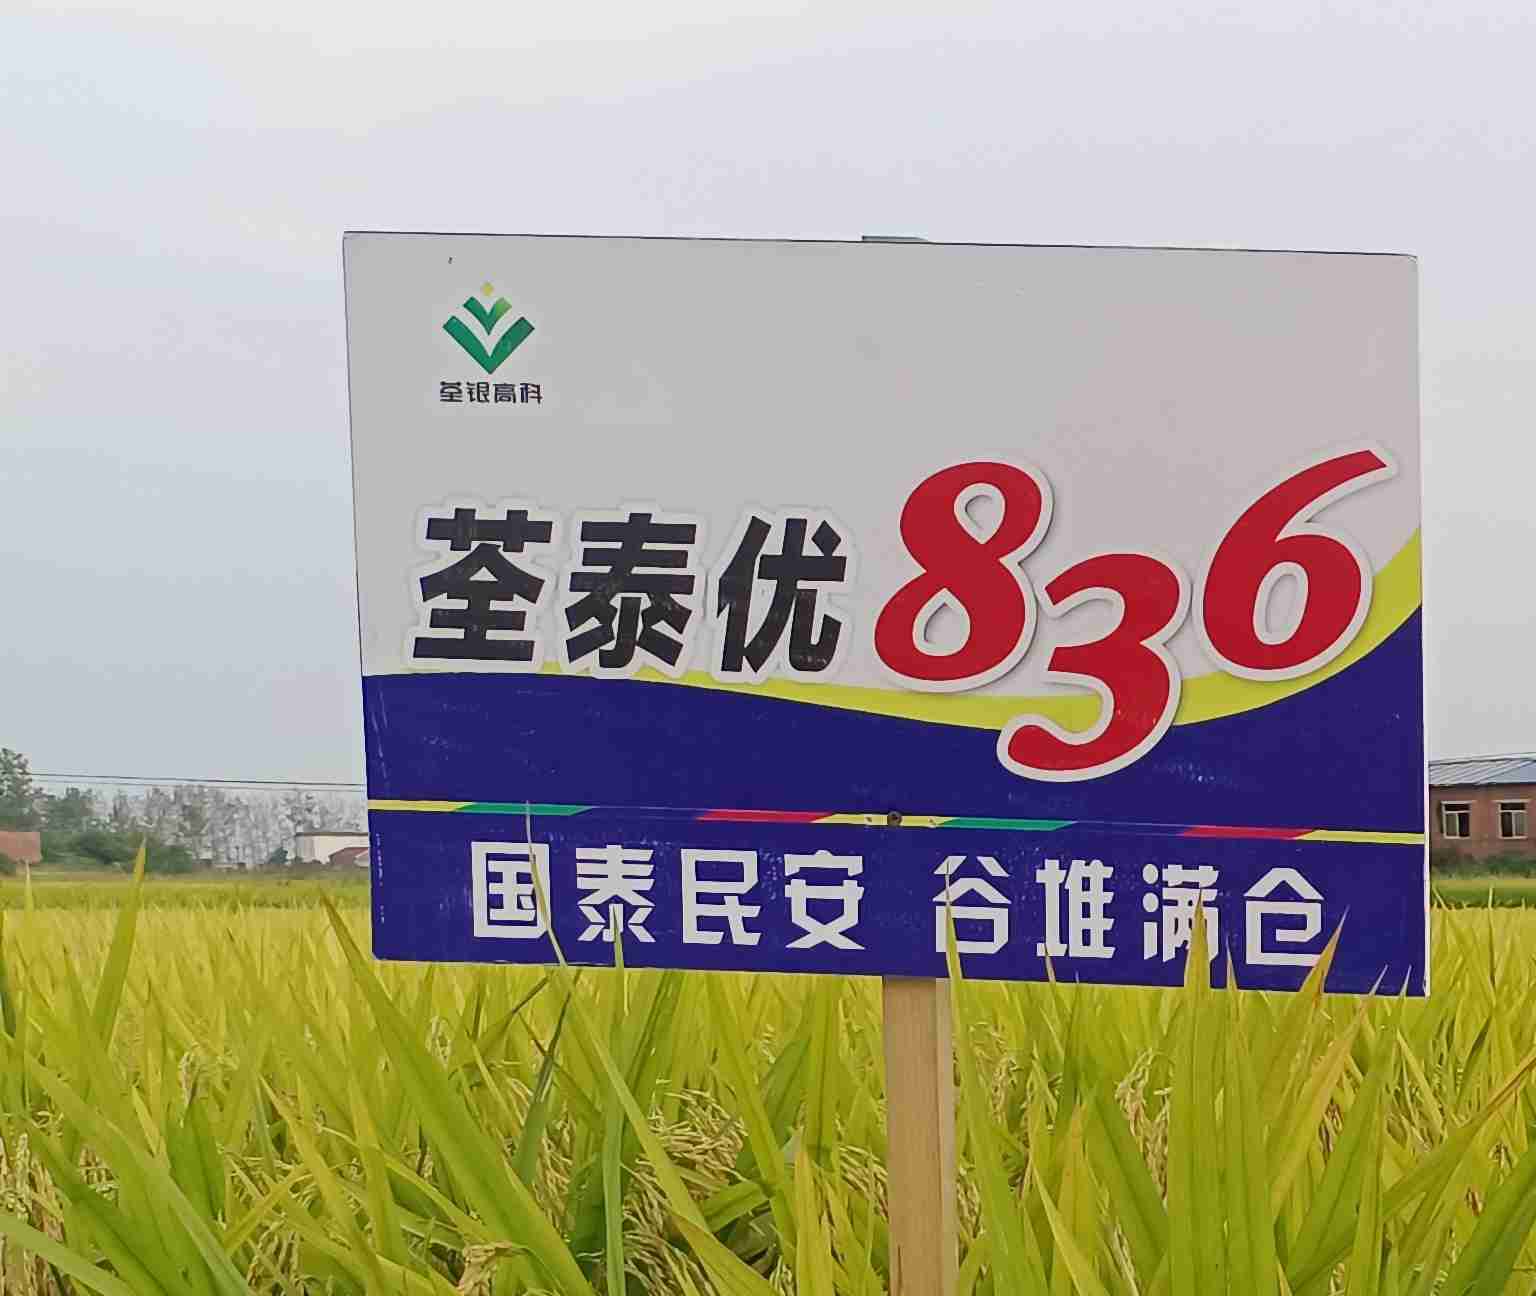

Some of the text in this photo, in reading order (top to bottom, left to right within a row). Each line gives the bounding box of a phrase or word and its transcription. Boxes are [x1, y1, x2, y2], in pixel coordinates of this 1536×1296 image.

[440, 381, 543, 404] 荃银高科
[471, 841, 1324, 966] 国泰民安 谷堆满仓
